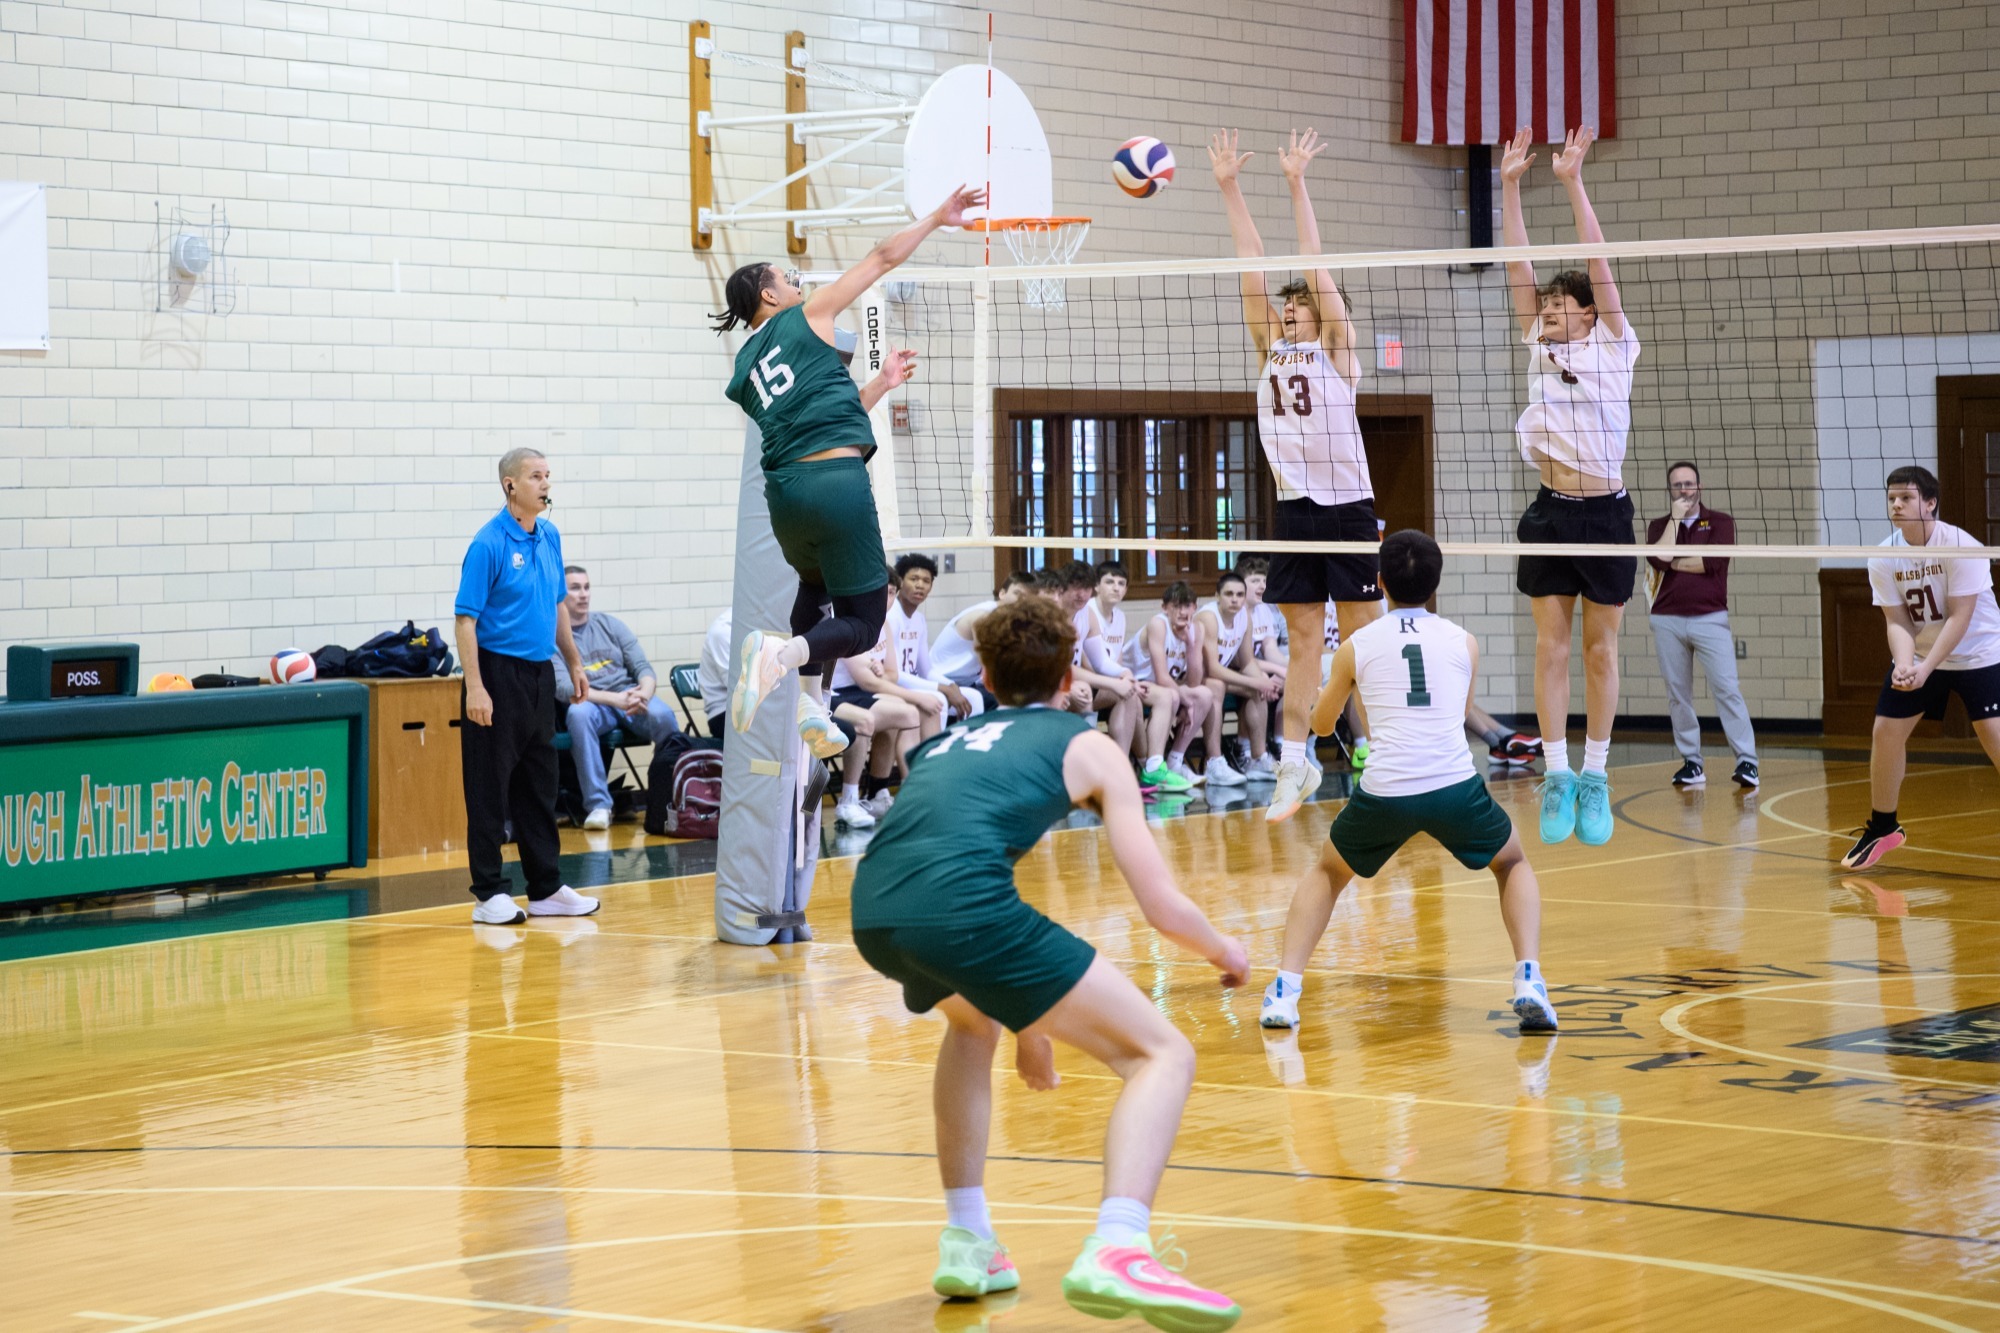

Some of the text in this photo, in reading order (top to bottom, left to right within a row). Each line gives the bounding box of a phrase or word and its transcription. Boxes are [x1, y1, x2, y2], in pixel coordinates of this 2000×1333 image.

[867, 306, 880, 371] PORTER
[750, 345, 795, 410] 15
[1269, 374, 1312, 417] 13
[1399, 617, 1420, 634] R
[1906, 584, 1943, 622] 21
[67, 670, 101, 687] POSS.
[1401, 643, 1431, 707] 1
[0, 761, 328, 867] UGH ATHLETIC CENTER
